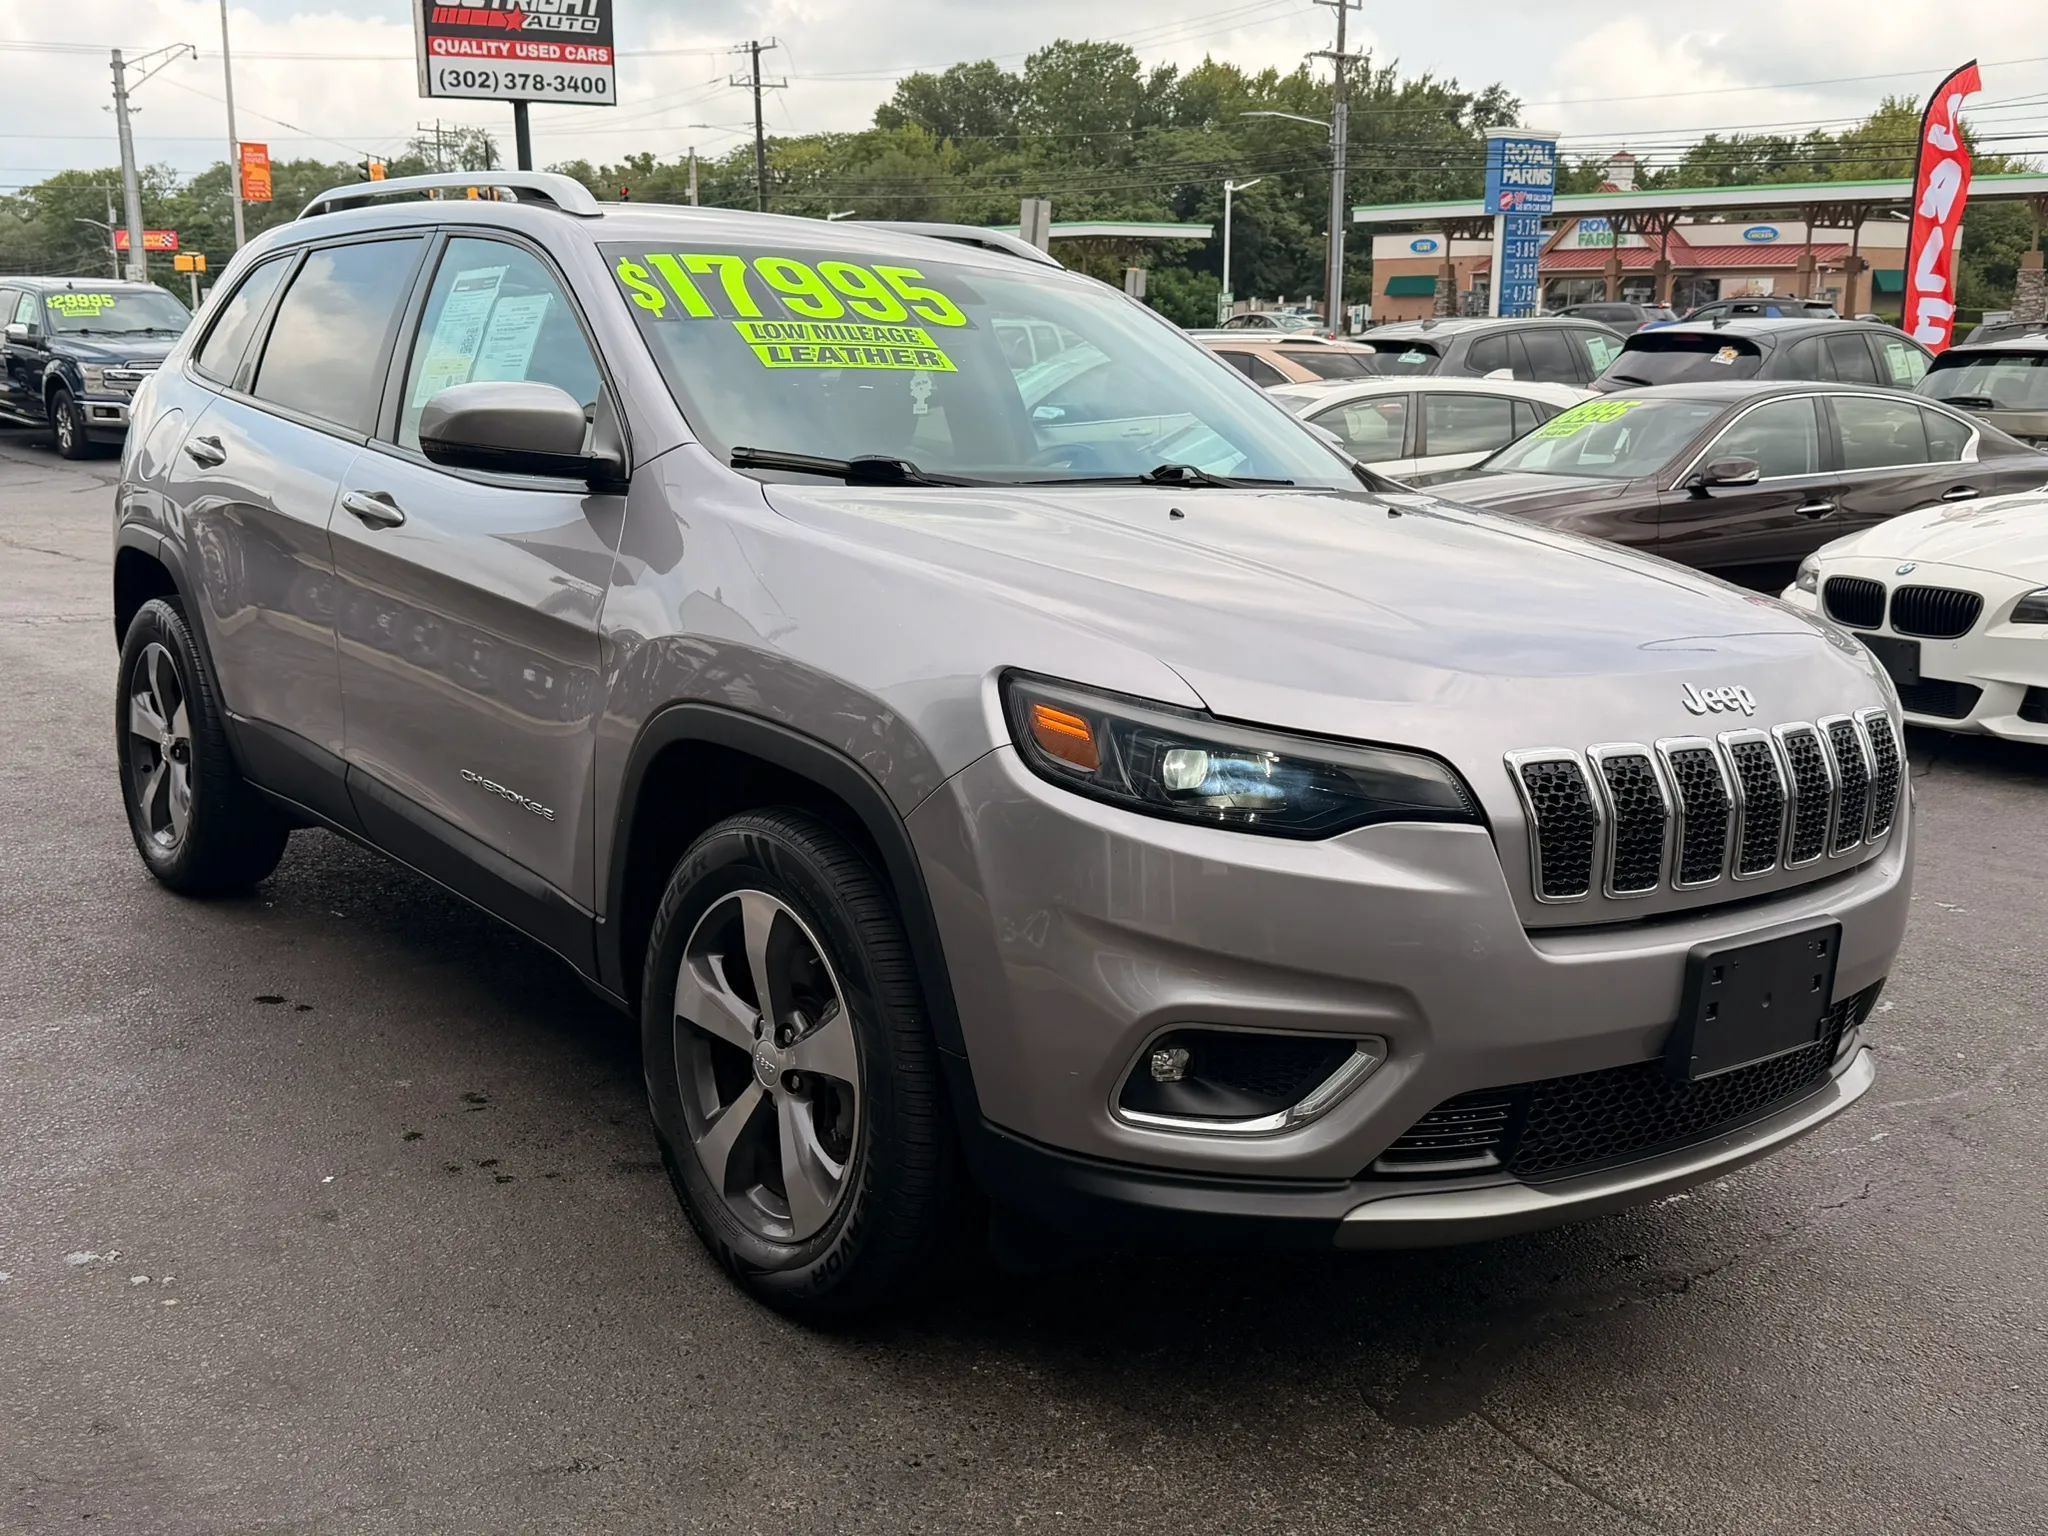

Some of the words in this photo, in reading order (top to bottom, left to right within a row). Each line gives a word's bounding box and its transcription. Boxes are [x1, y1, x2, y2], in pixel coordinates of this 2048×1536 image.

[527, 14, 598, 32] AUTO
[433, 39, 510, 57] QUALITY
[515, 44, 560, 59] USED
[565, 48, 608, 62] CARS
[439, 68, 499, 92] (302)
[504, 73, 607, 94] 378-3400
[1503, 142, 1553, 165] ROYAL
[1503, 164, 1552, 186] FARMS
[1579, 217, 1613, 233] ROY
[46, 294, 115, 308] $29995
[616, 253, 967, 327] $17995
[750, 322, 805, 343] LOW
[811, 324, 921, 346] MILEAGE
[768, 345, 944, 368] LEATHER
[1681, 682, 1757, 717] Jeep
[460, 768, 556, 822] CHEROKEE
